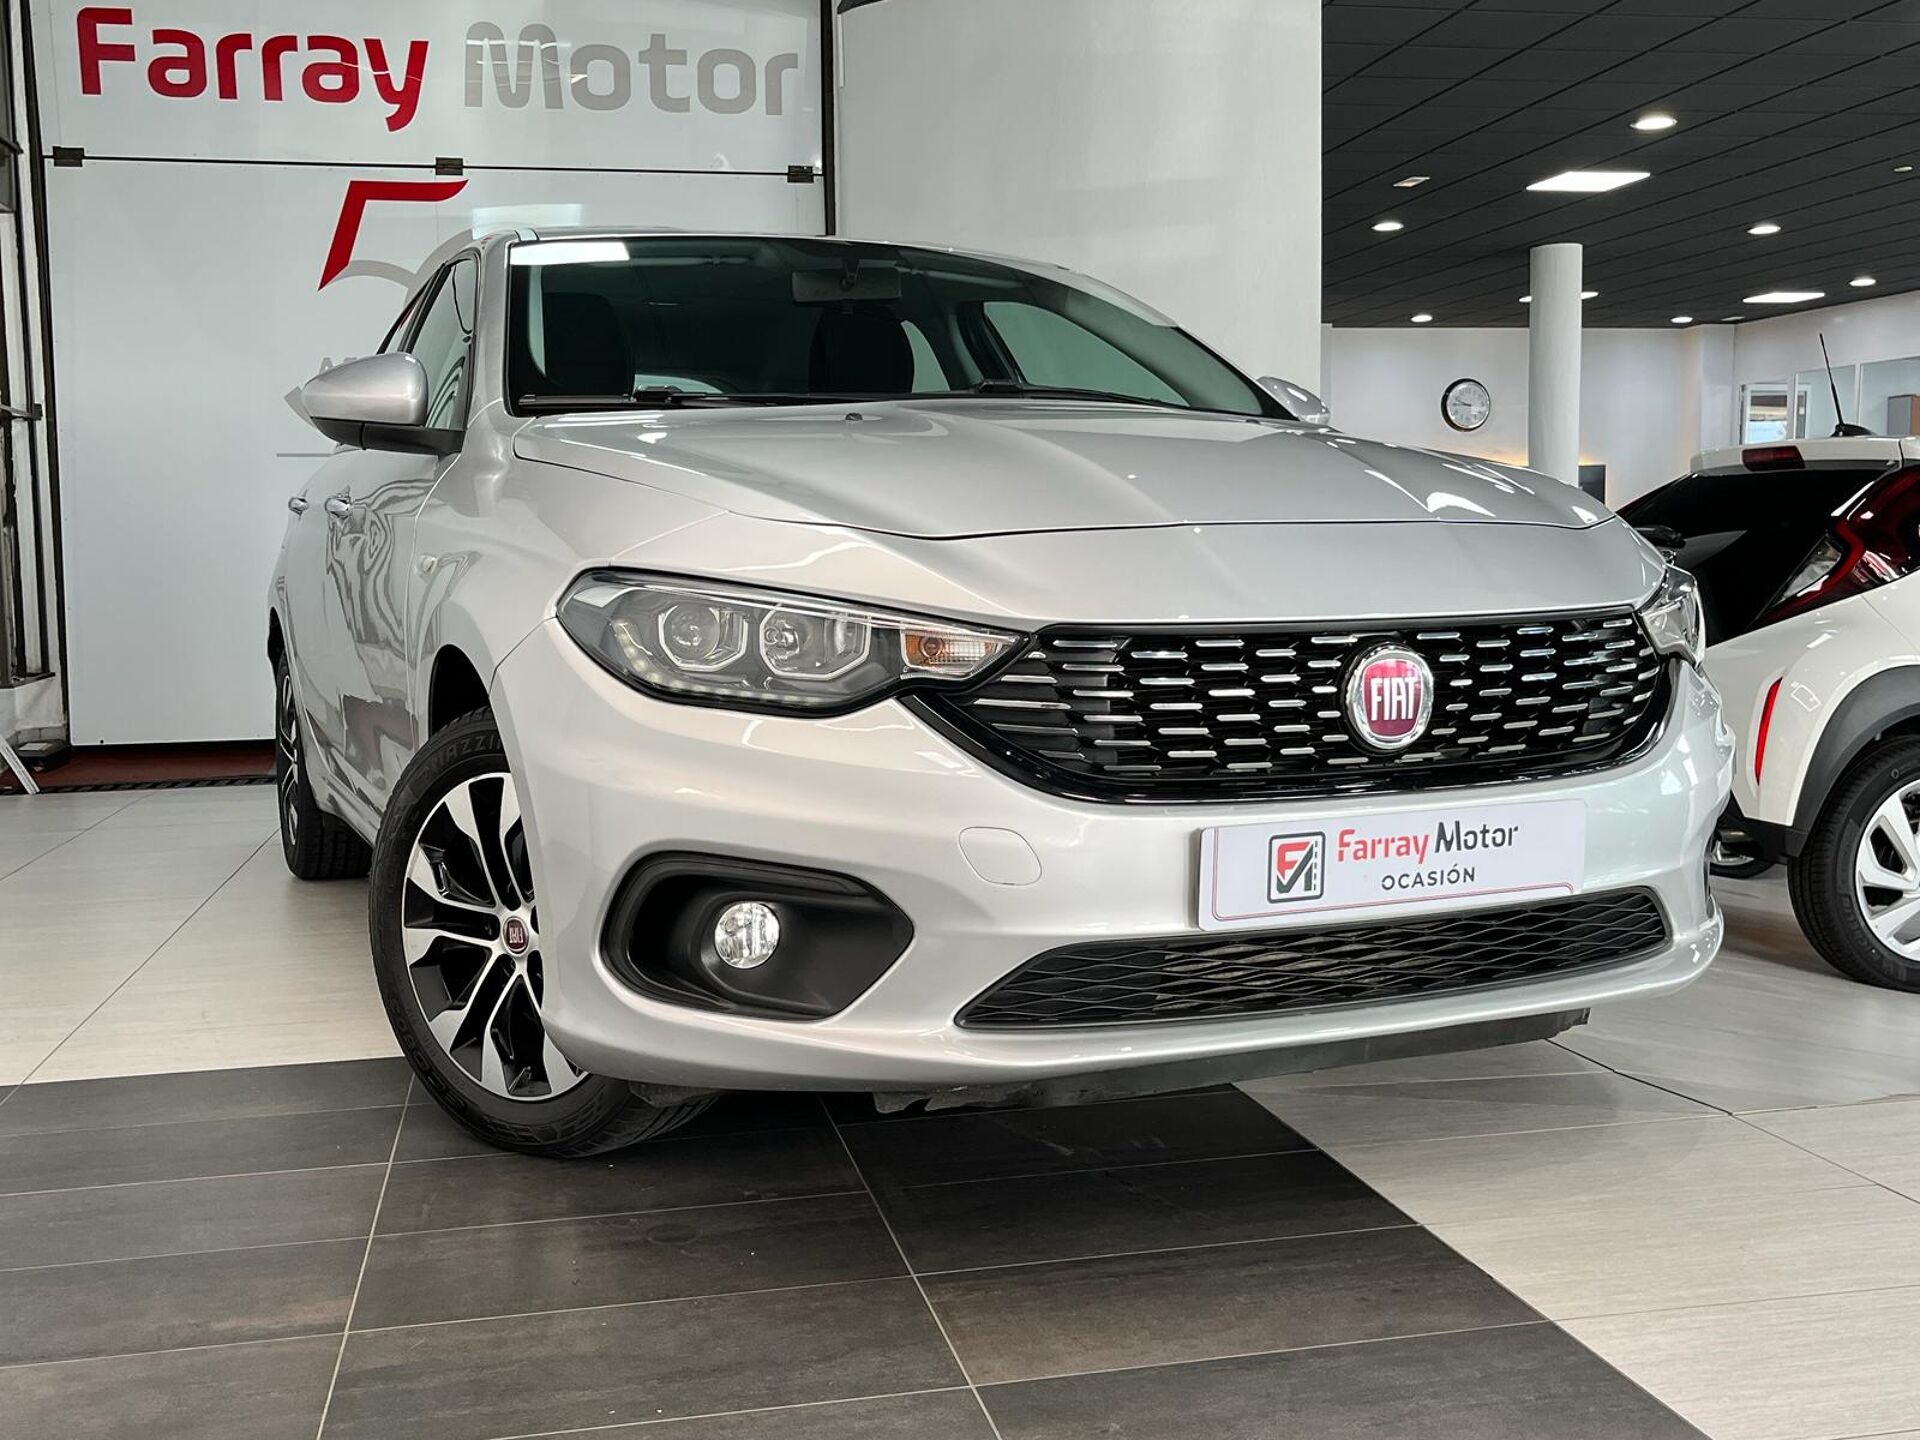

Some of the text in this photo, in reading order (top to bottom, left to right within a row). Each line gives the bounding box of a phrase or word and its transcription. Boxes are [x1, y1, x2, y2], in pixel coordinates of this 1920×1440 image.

[76, 7, 798, 132] Farray Motor
[1370, 676, 1419, 721] FIAT
[1338, 820, 1518, 864] Farray Motor
[1381, 864, 1476, 891] OCASIÓN
